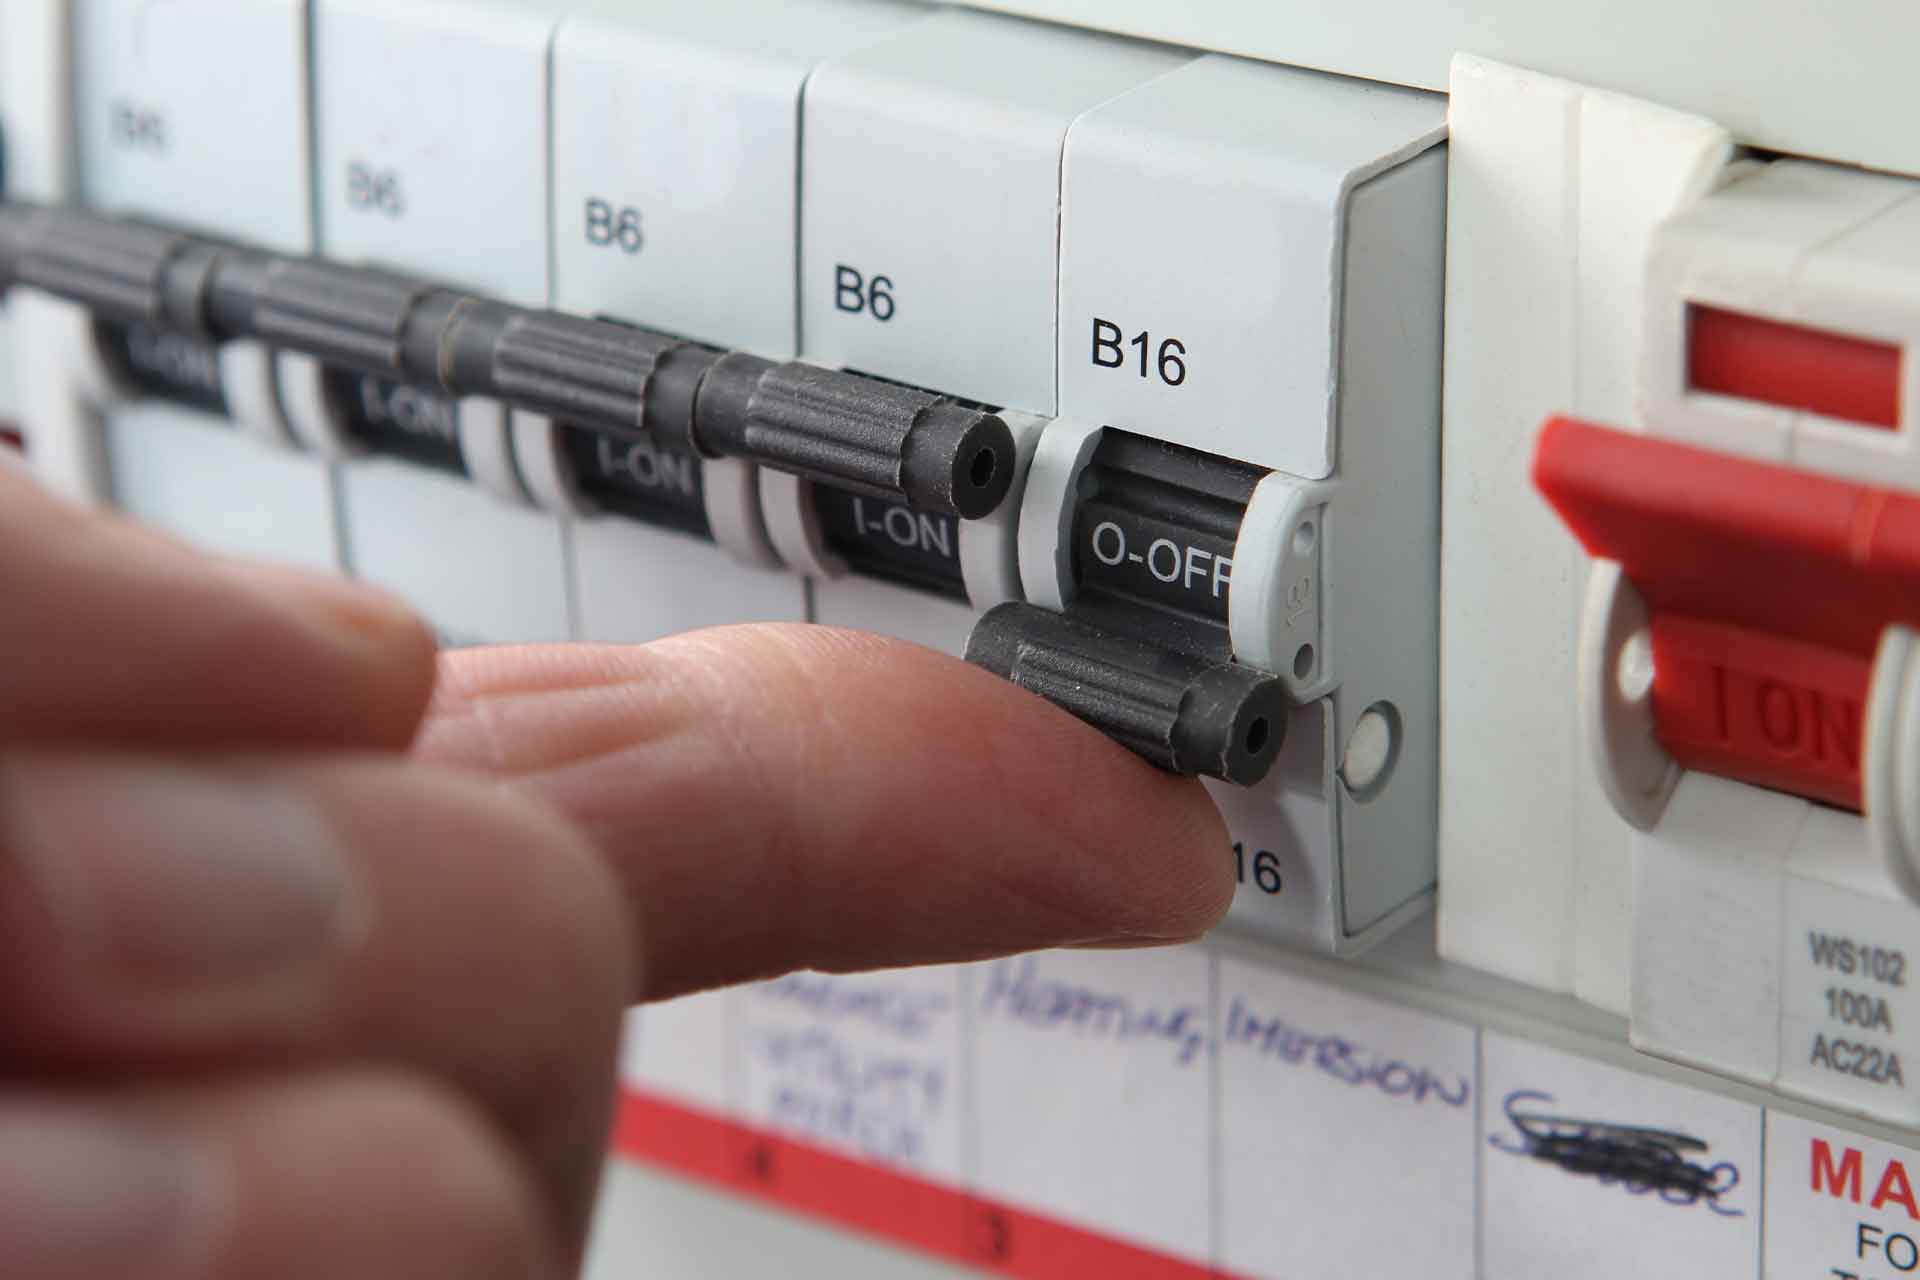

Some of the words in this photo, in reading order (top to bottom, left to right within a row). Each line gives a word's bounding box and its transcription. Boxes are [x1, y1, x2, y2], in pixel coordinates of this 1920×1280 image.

[345, 161, 404, 219] B6
[585, 199, 643, 254] B6
[835, 265, 896, 322] B6
[1091, 318, 1188, 387] B16
[597, 437, 693, 494] I-ON
[852, 497, 951, 558] I-ON
[1092, 521, 1233, 598] O-OFF
[1755, 676, 1861, 770] ON
[1232, 841, 1282, 894] 16
[1807, 929, 1906, 988] WS102
[1825, 985, 1893, 1036] 100A
[1808, 1033, 1905, 1089] AC22A
[1811, 1137, 1920, 1222] MA
[1857, 1223, 1919, 1271] FO
